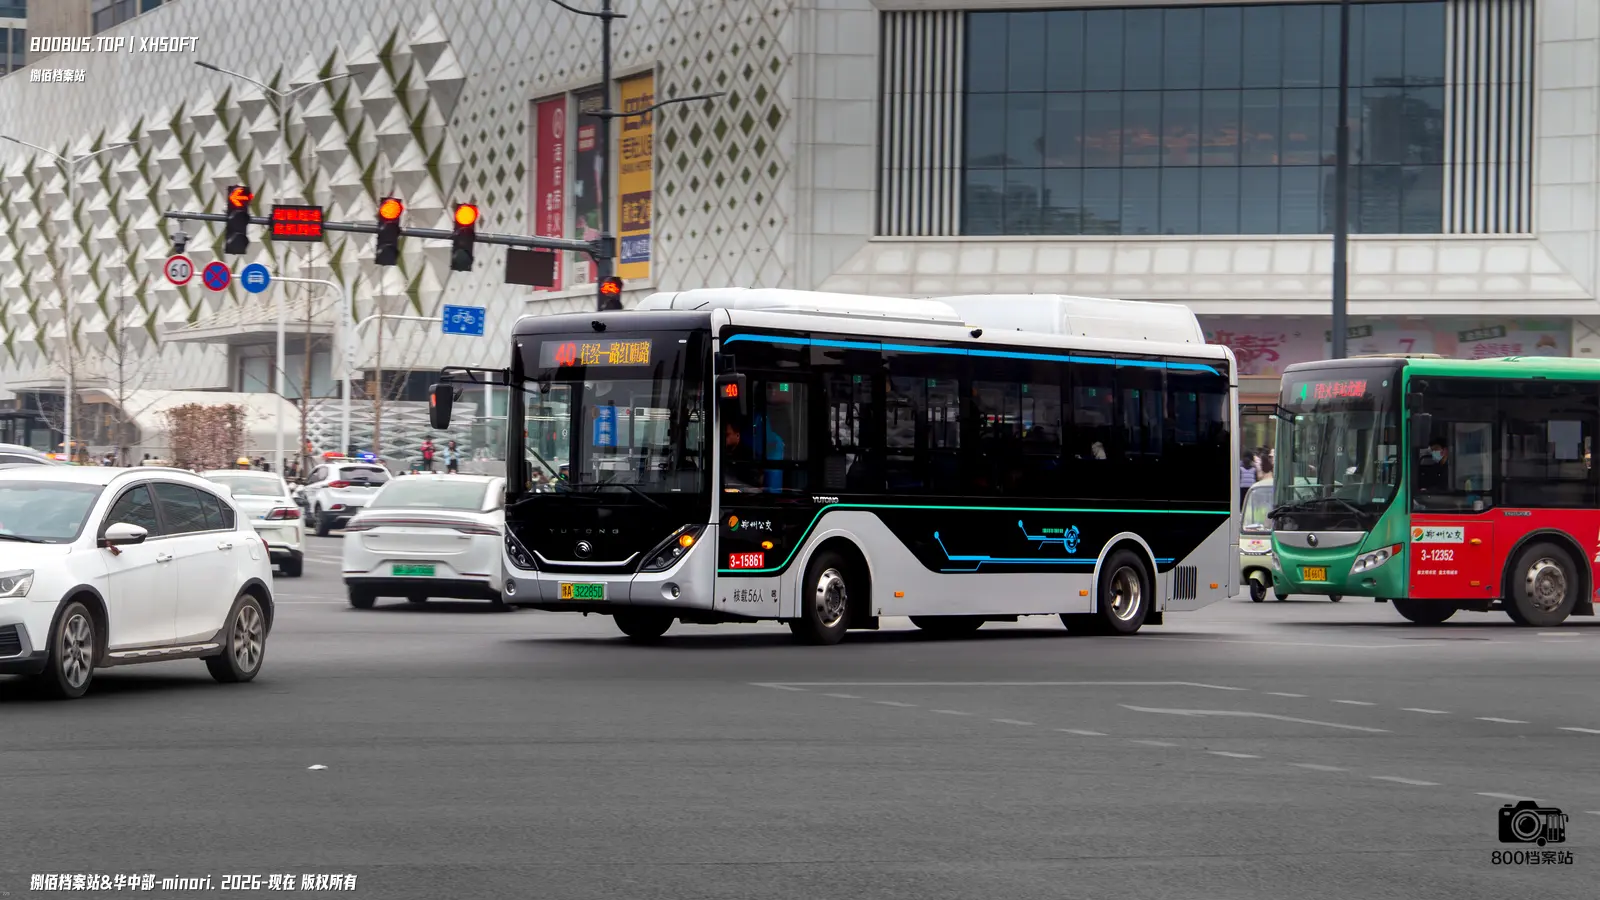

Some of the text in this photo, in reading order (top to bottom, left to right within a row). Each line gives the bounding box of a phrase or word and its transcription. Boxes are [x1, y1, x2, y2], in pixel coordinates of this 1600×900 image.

[171, 263, 188, 277] 60
[555, 342, 577, 366] 40
[726, 384, 738, 397] 40
[812, 496, 838, 504] YUTONG
[741, 519, 773, 531] 郑州公交
[1425, 530, 1463, 541] 郑州公交
[730, 554, 763, 568] 3-15861
[1421, 549, 1454, 561] 3-12352
[733, 589, 764, 602] 核载56人
